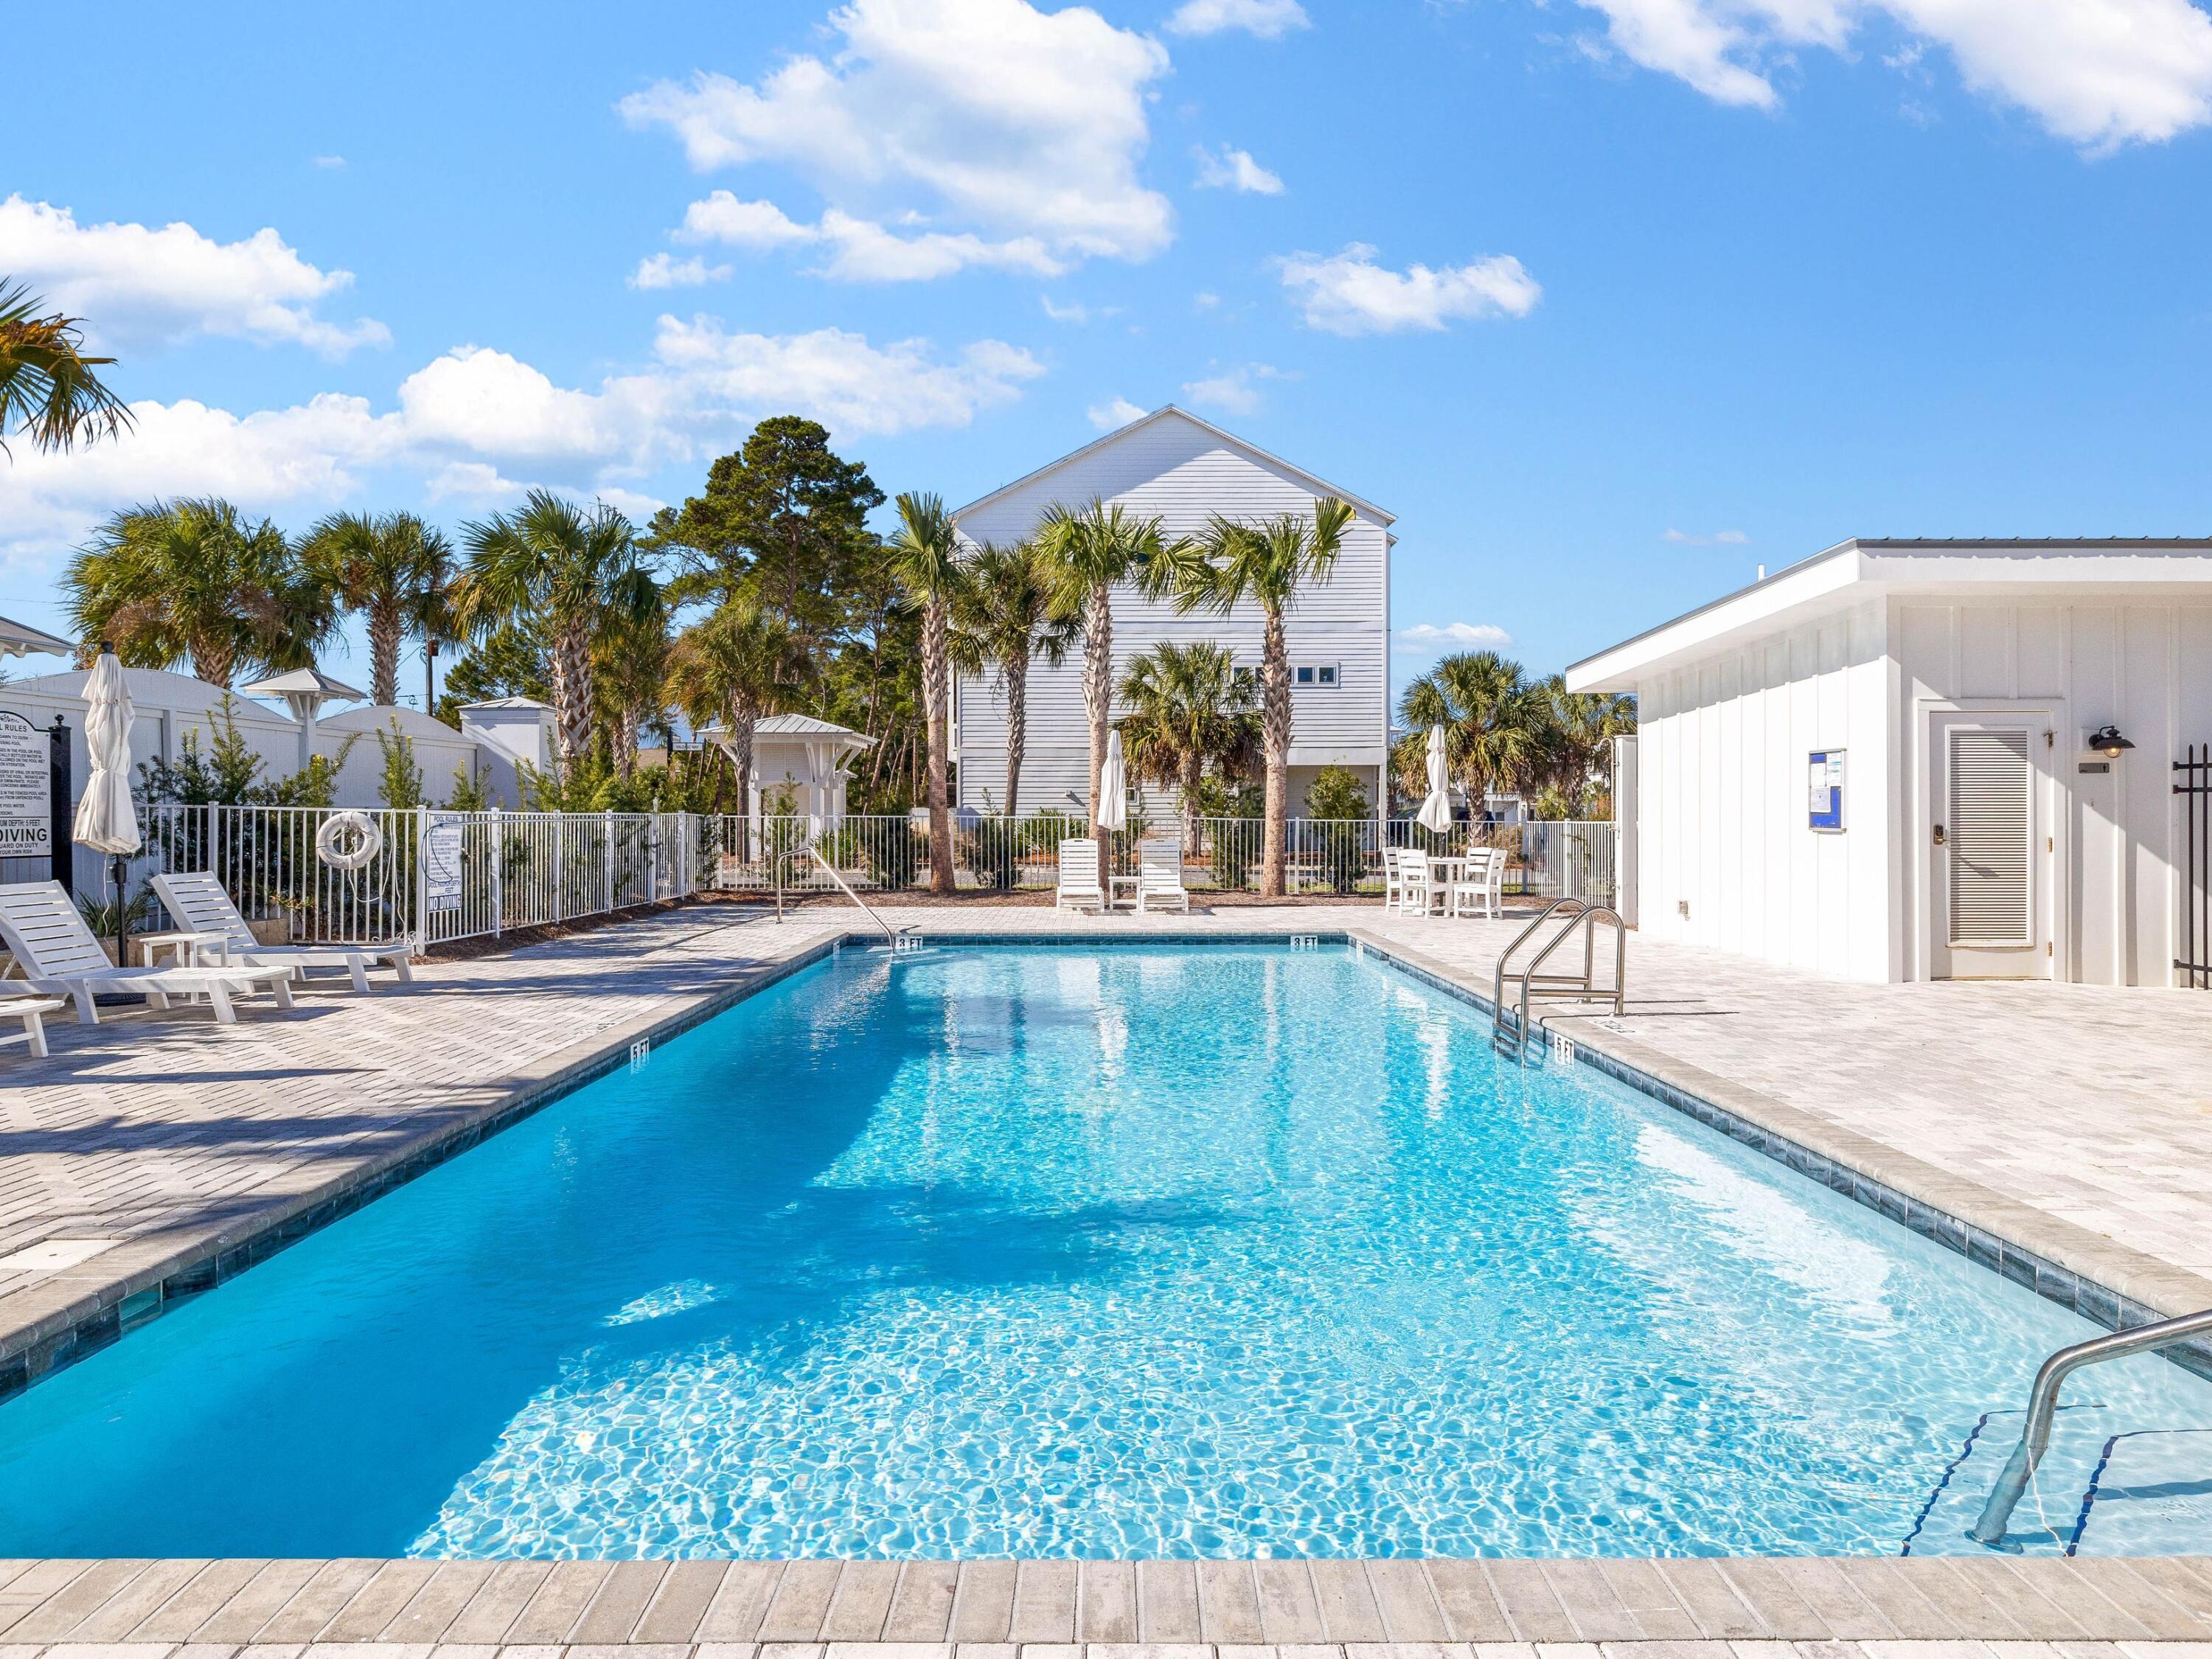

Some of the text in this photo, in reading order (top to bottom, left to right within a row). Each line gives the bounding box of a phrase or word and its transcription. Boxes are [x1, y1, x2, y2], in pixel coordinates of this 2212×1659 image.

[4, 724, 27, 732] RULES
[429, 894, 461, 911] NO DIVING
[900, 938, 905, 947] 3
